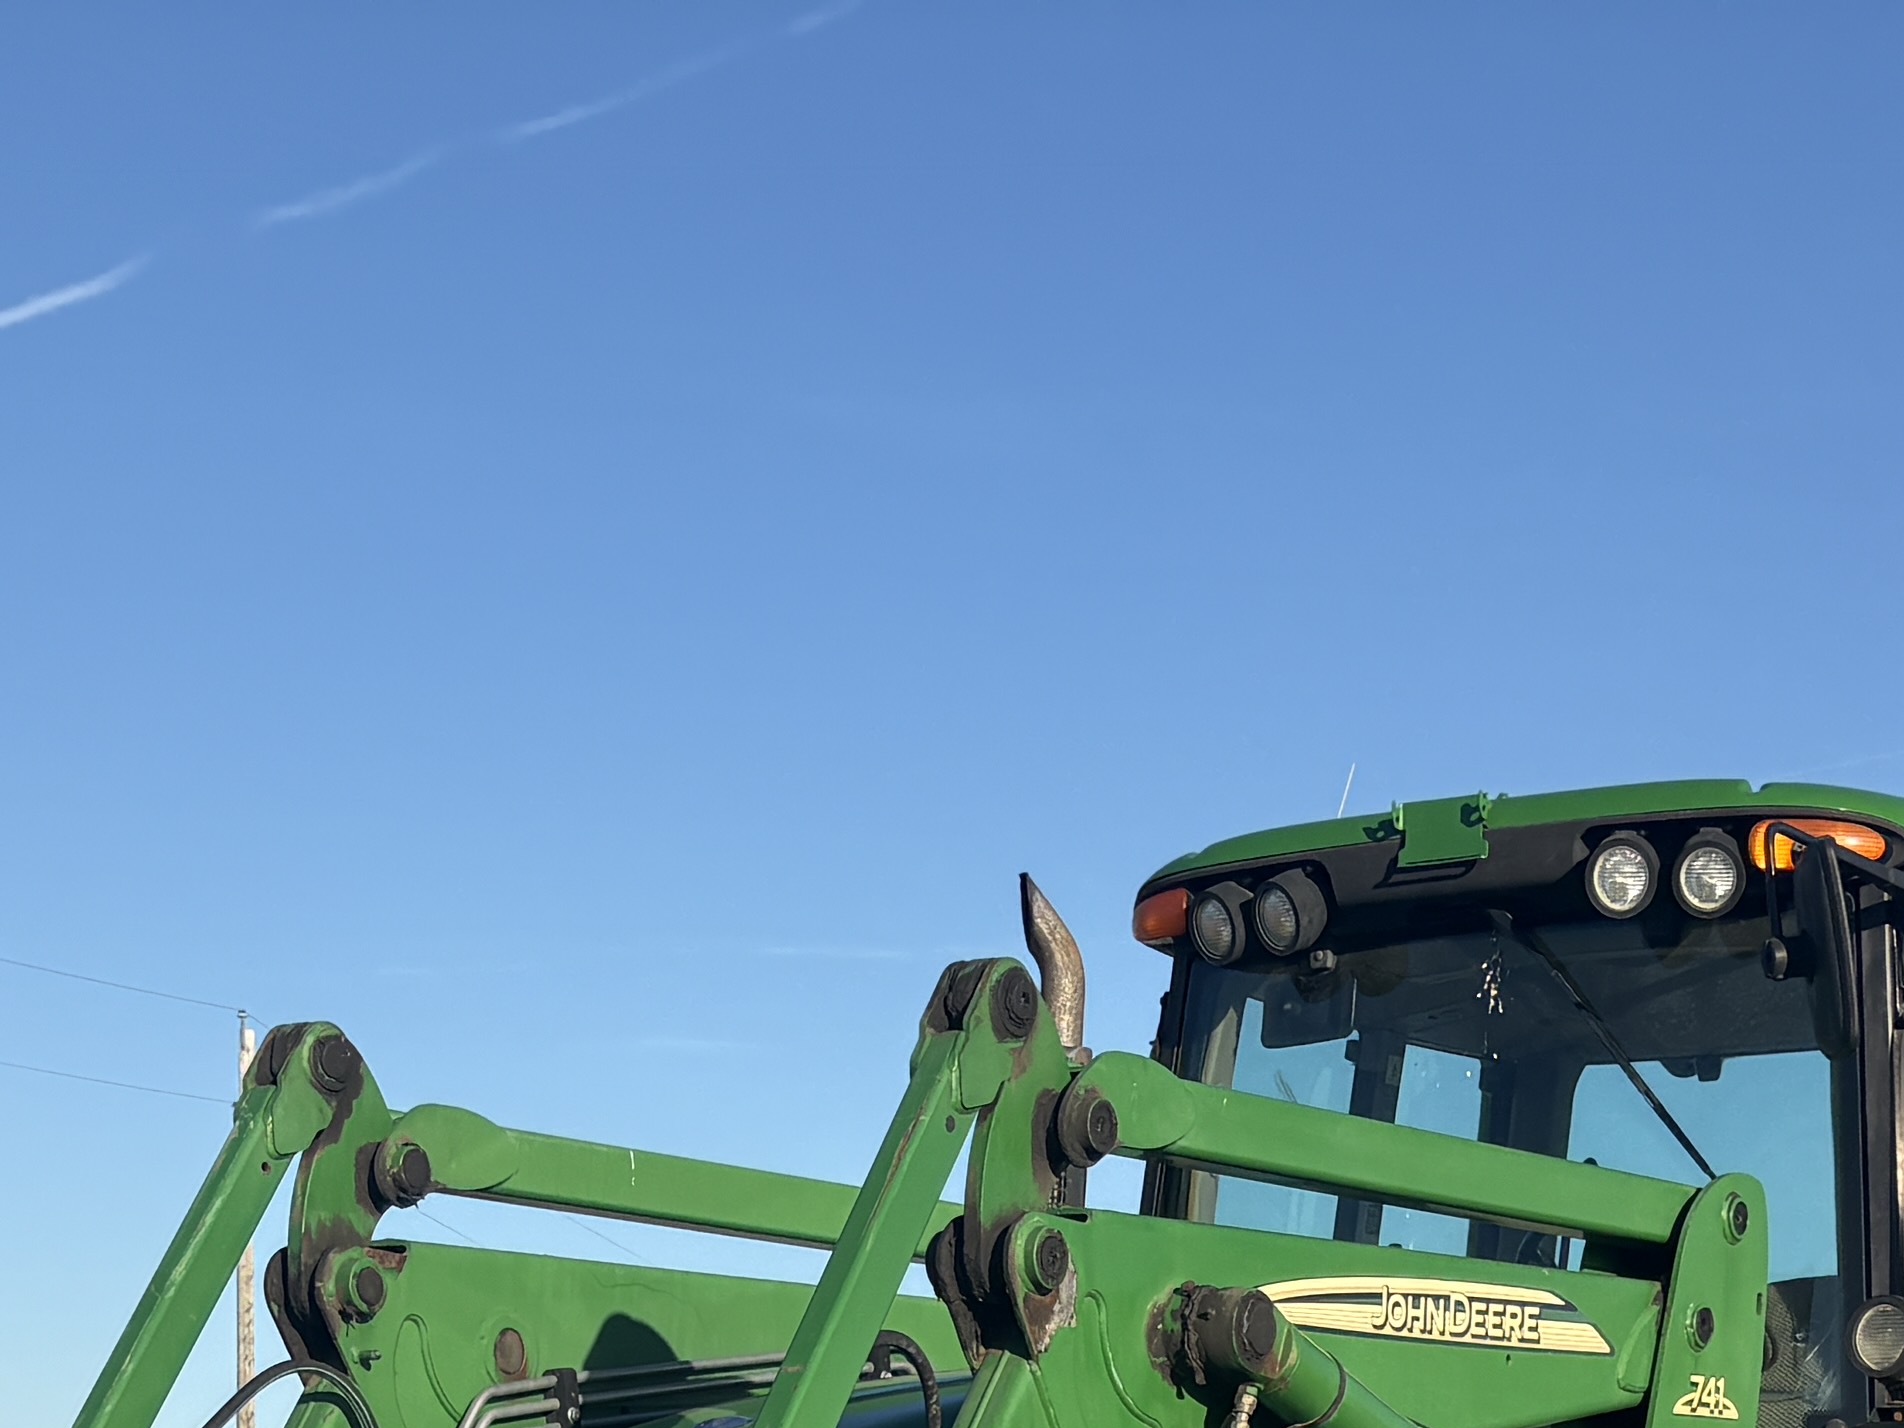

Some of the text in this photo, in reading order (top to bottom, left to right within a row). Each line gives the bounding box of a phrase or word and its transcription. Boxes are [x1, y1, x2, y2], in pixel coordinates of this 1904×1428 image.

[1371, 1285, 1541, 1344] JOHN DEERE
[1689, 1374, 1725, 1413] 741
